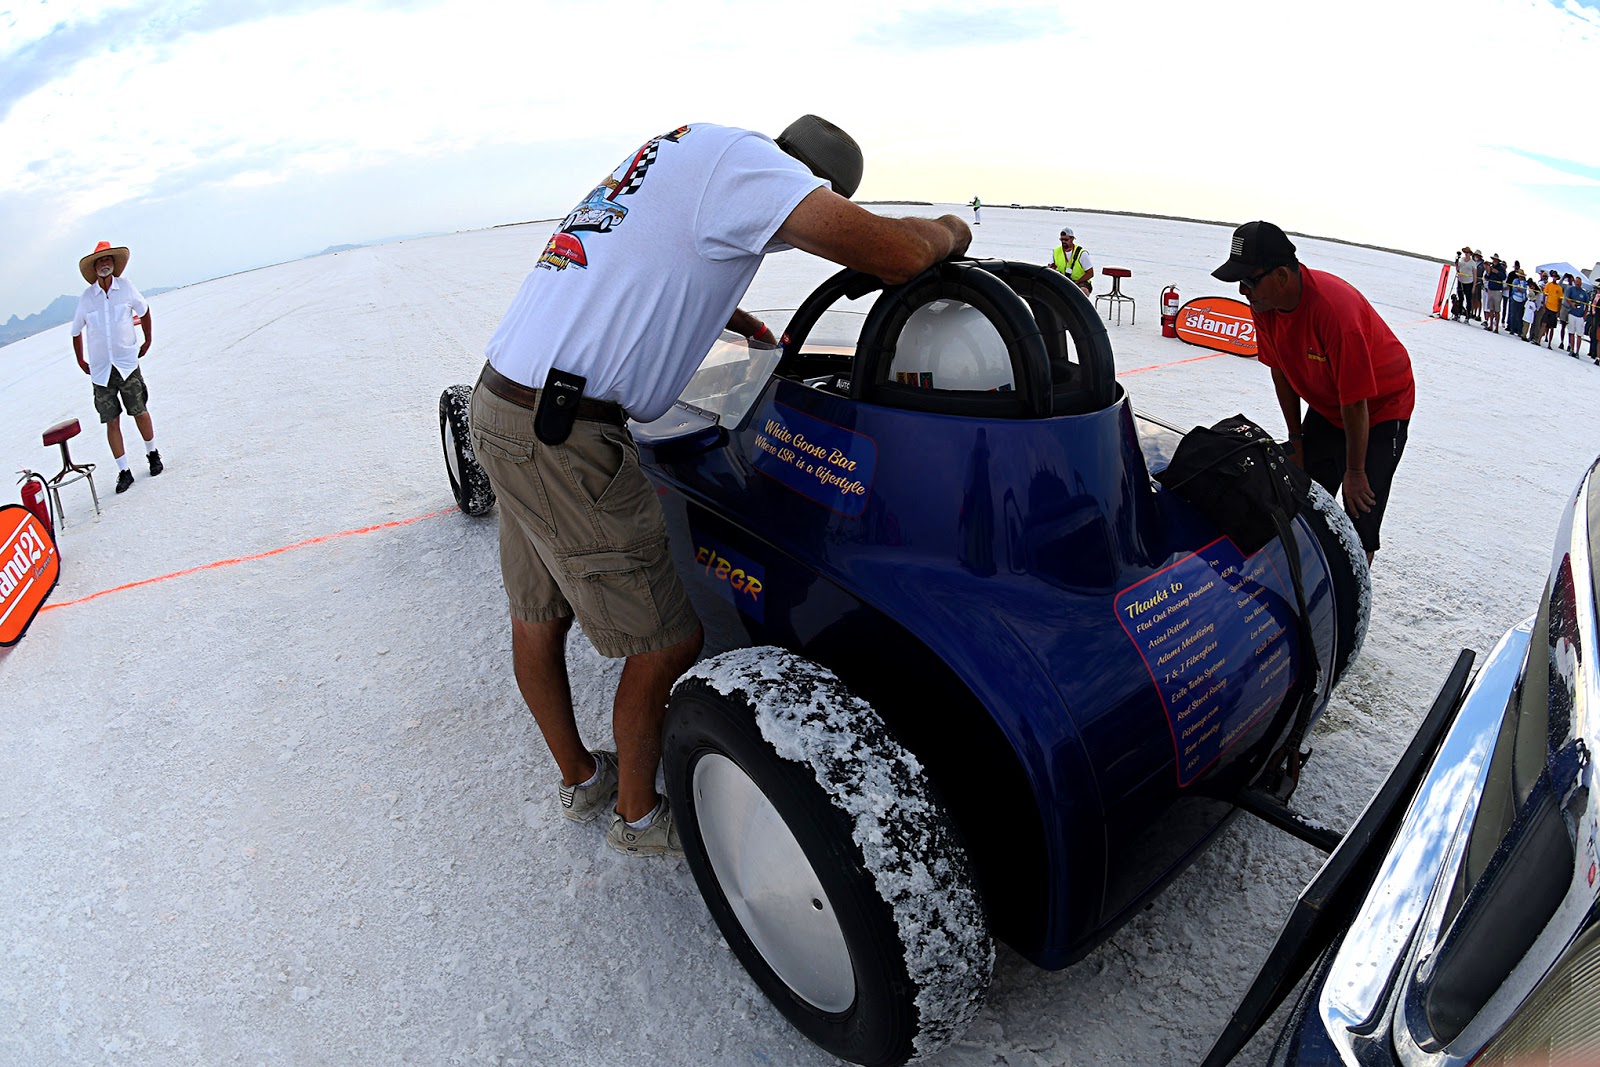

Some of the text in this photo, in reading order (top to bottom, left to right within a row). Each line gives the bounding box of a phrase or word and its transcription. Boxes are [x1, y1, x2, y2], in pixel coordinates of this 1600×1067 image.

[754, 434, 866, 496] Where LSR is a lifestyle
[764, 419, 857, 472] White Goose Bar
[0, 524, 46, 604] and21
[1124, 582, 1183, 618] Thanks to
[1136, 582, 1214, 634] Flat Out Racing Products
[1148, 618, 1190, 649] Arias Pistons
[1157, 623, 1214, 666] Adams Metalizing
[1165, 641, 1218, 684] J & J Fiberglass
[1188, 676, 1204, 690] Turbo
[1204, 658, 1226, 678] Systems
[1178, 704, 1192, 721] Real
[1192, 692, 1208, 710] Street
